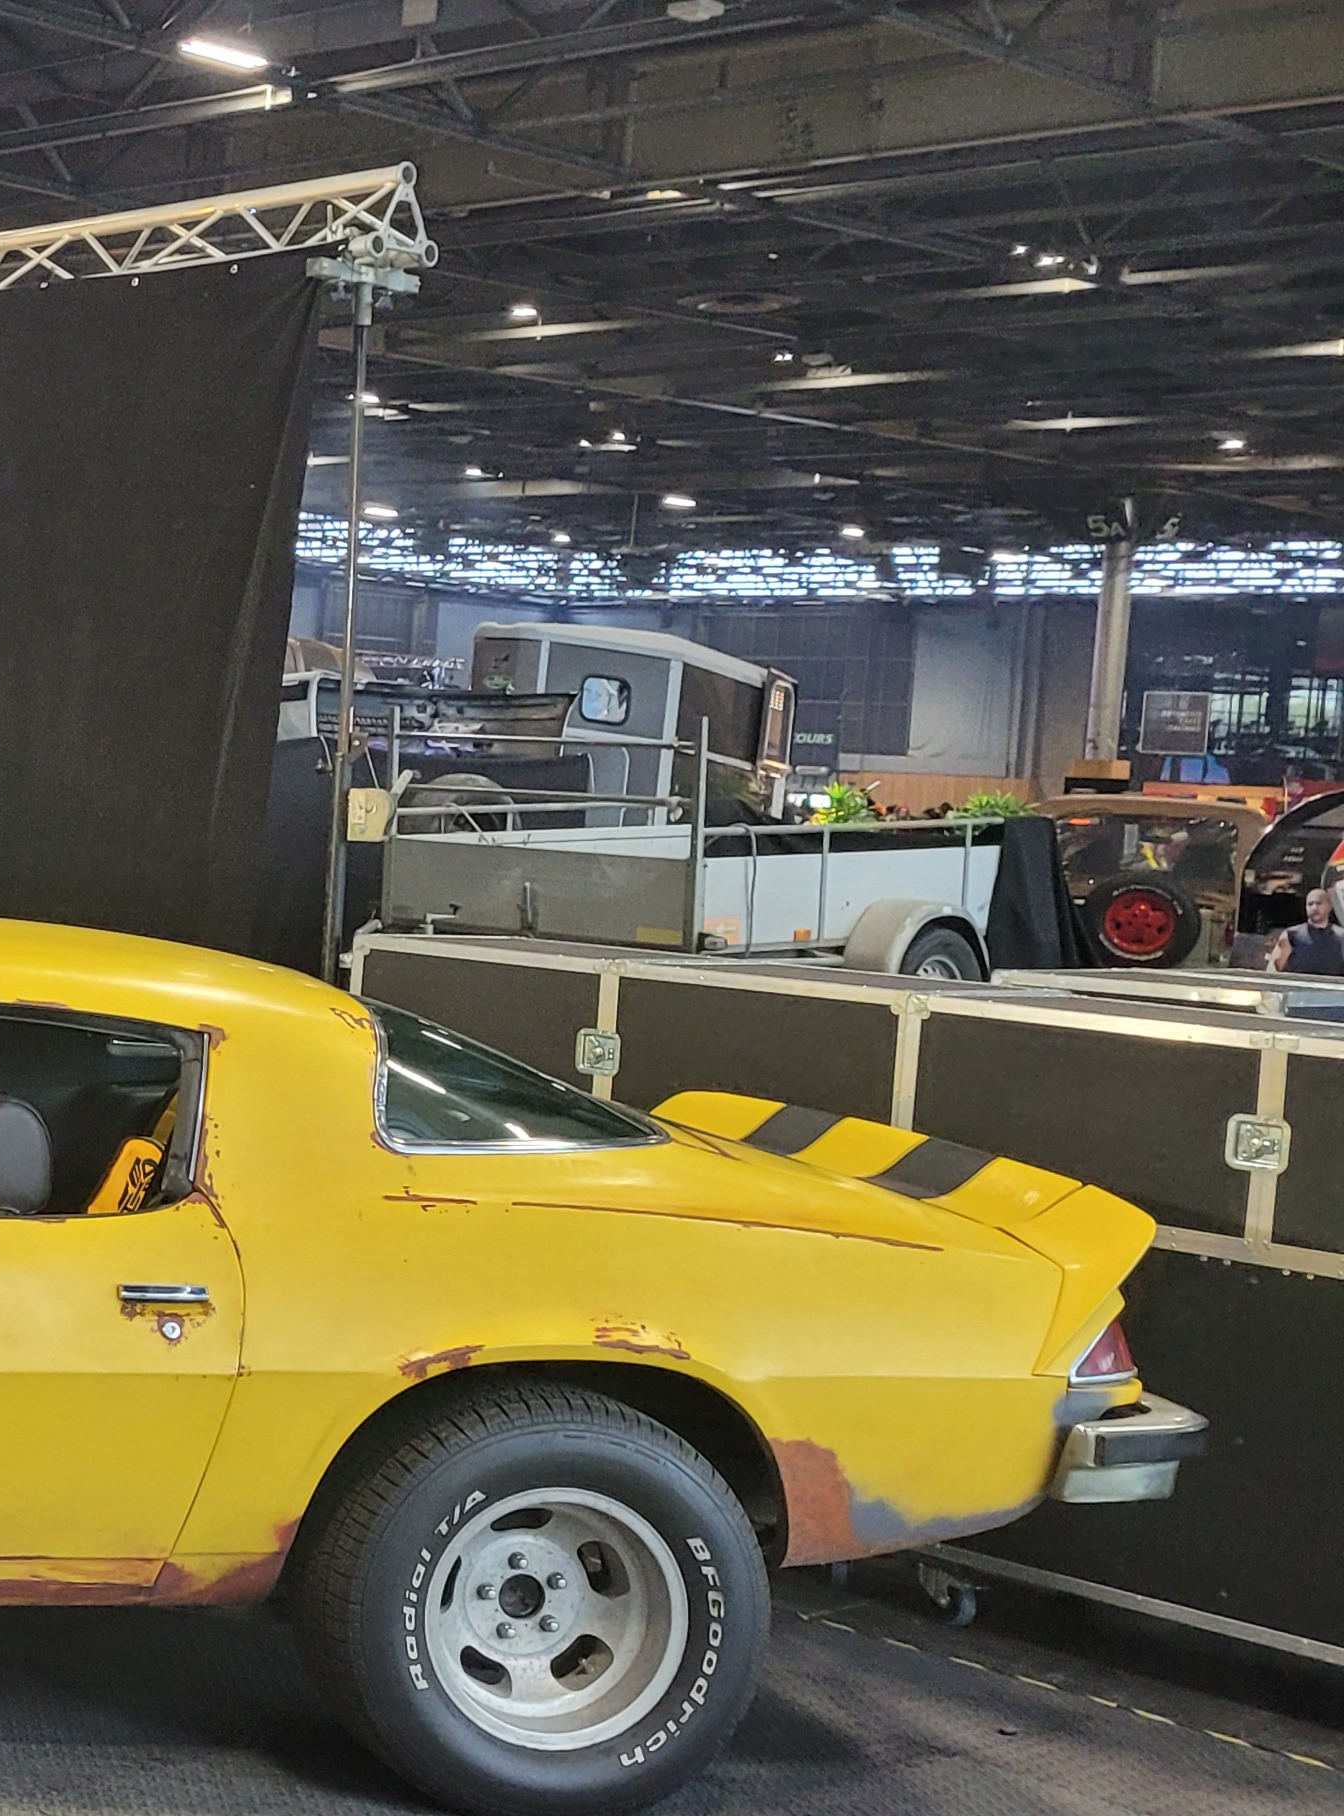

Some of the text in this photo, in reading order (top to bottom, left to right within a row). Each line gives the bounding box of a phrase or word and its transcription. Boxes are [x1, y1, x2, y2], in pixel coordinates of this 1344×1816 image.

[401, 1489, 488, 1692] Radial T/A
[617, 1536, 727, 1768] BFGoodrich
